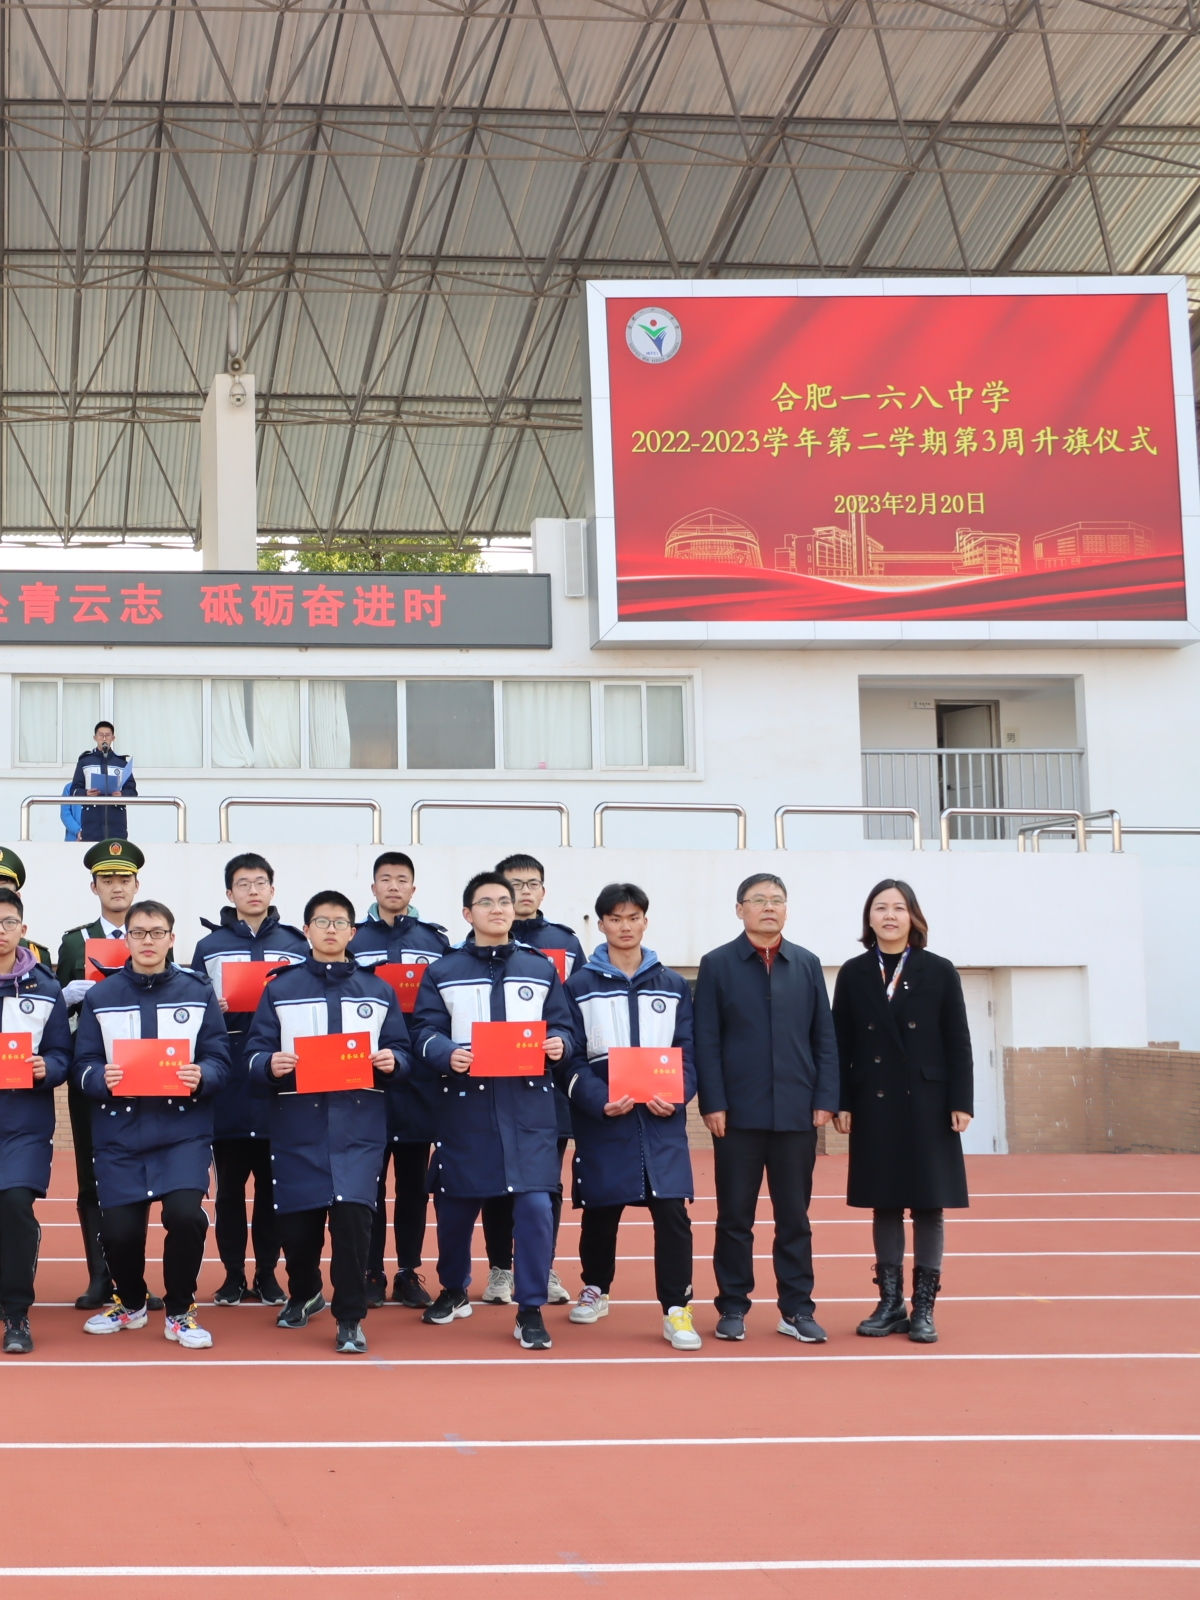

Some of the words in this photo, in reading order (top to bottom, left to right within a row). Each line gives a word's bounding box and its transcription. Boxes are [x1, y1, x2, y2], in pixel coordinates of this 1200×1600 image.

[771, 380, 1011, 414] 合肥一六八中学
[631, 425, 1158, 459] 2022-2023学年第二学期第3周升旗仪式
[834, 491, 986, 516] 2023年2月20日
[199, 583, 447, 628] 砥砺奋进时
